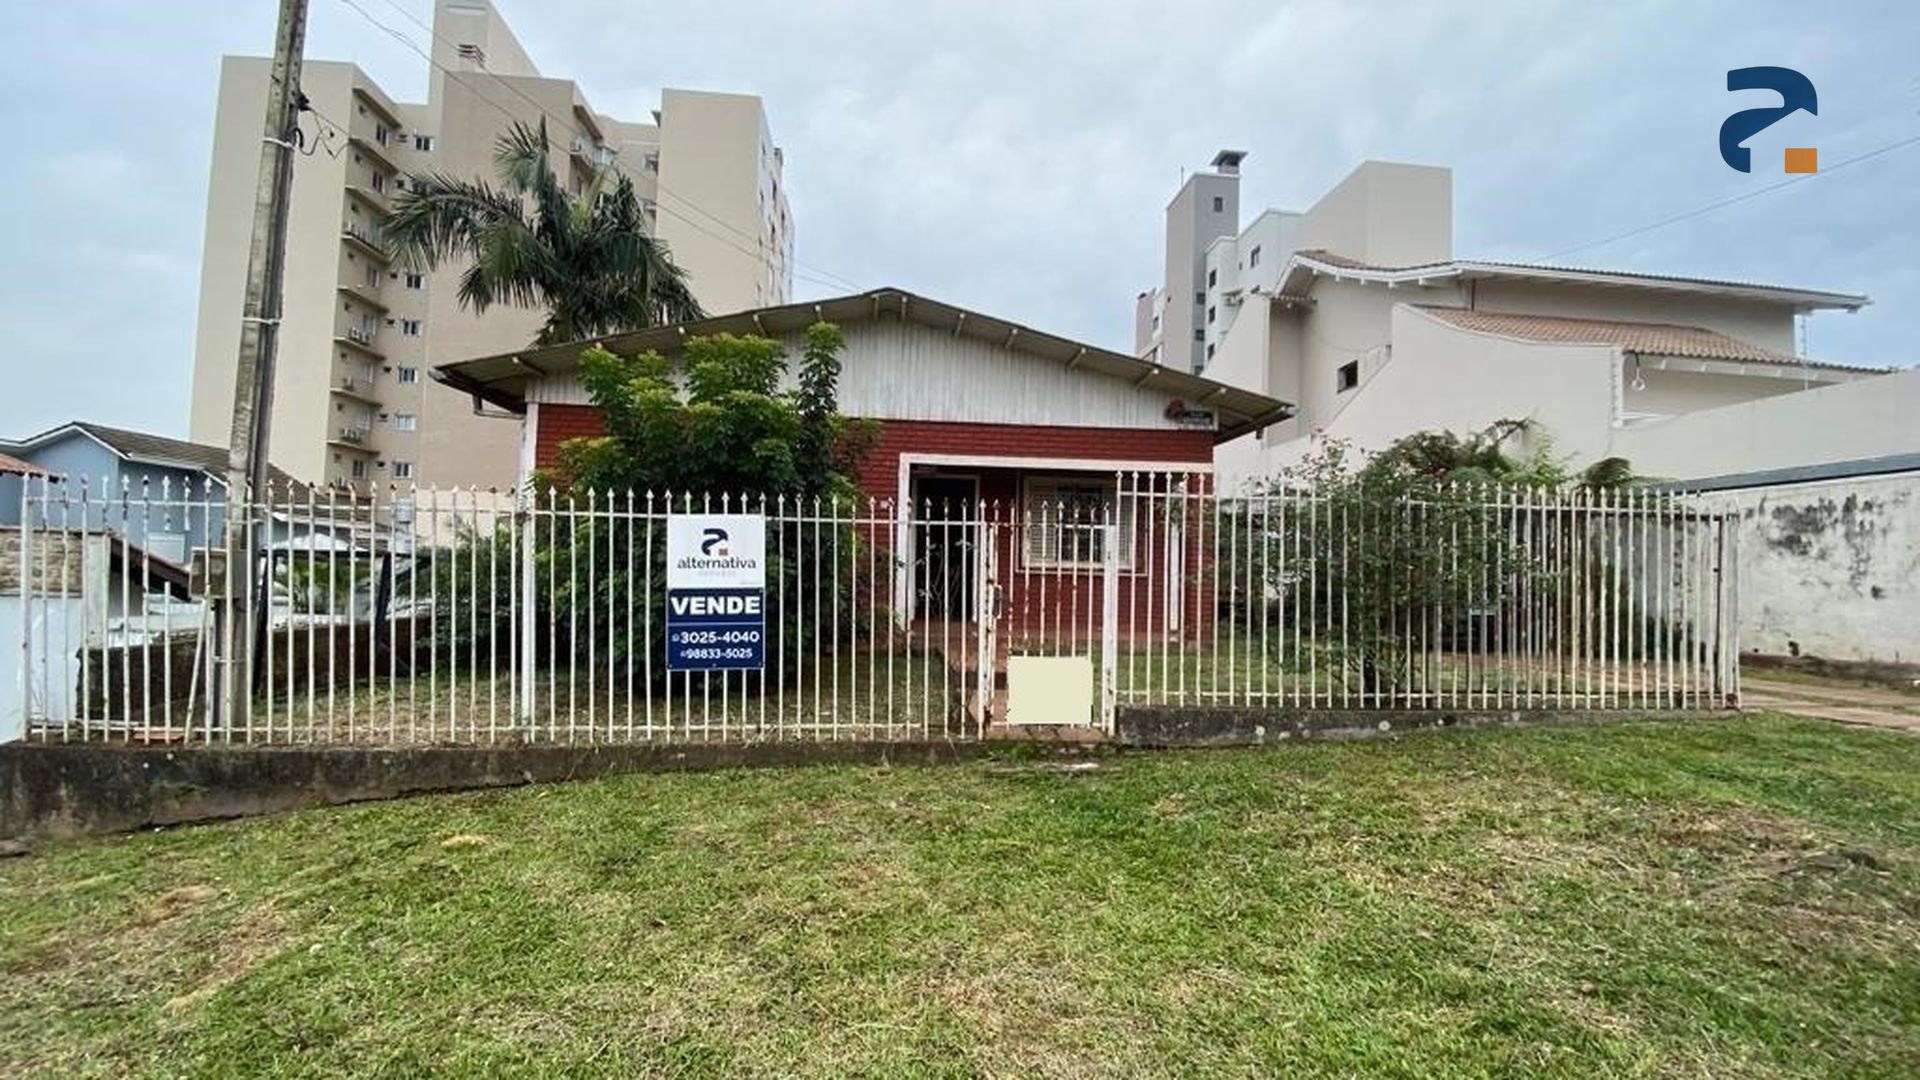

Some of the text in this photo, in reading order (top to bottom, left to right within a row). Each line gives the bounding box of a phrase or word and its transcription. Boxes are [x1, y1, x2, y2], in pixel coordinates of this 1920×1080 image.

[677, 556, 756, 569] alternativa
[671, 596, 761, 615] VENDE
[680, 631, 760, 644] 3025-4040
[686, 648, 753, 659] 98833-5025
